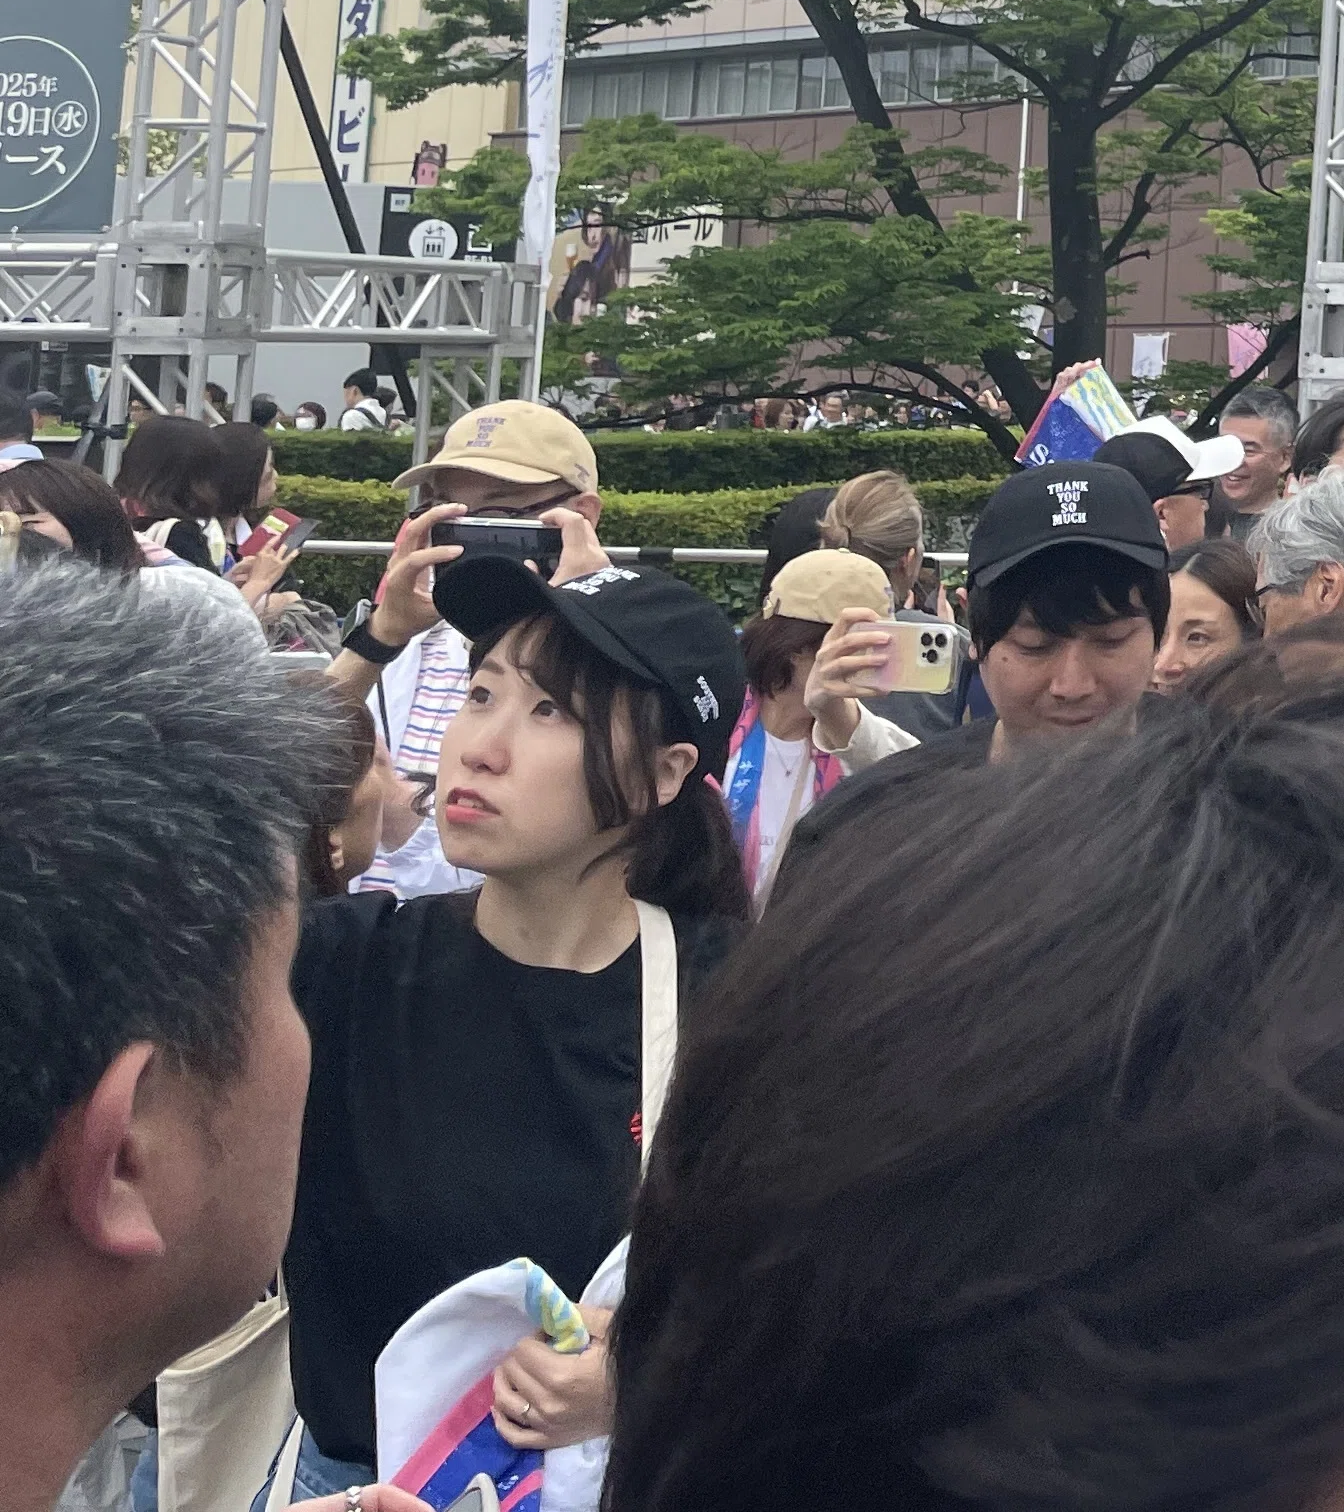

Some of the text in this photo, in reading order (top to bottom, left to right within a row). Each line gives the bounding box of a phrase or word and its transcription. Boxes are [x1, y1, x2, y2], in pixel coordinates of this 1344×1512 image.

[0, 143, 67, 176] ース
[1046, 480, 1089, 495] THANK
[1056, 490, 1081, 504] YOU
[1060, 501, 1077, 514] SO
[1052, 512, 1087, 526] MUCH
